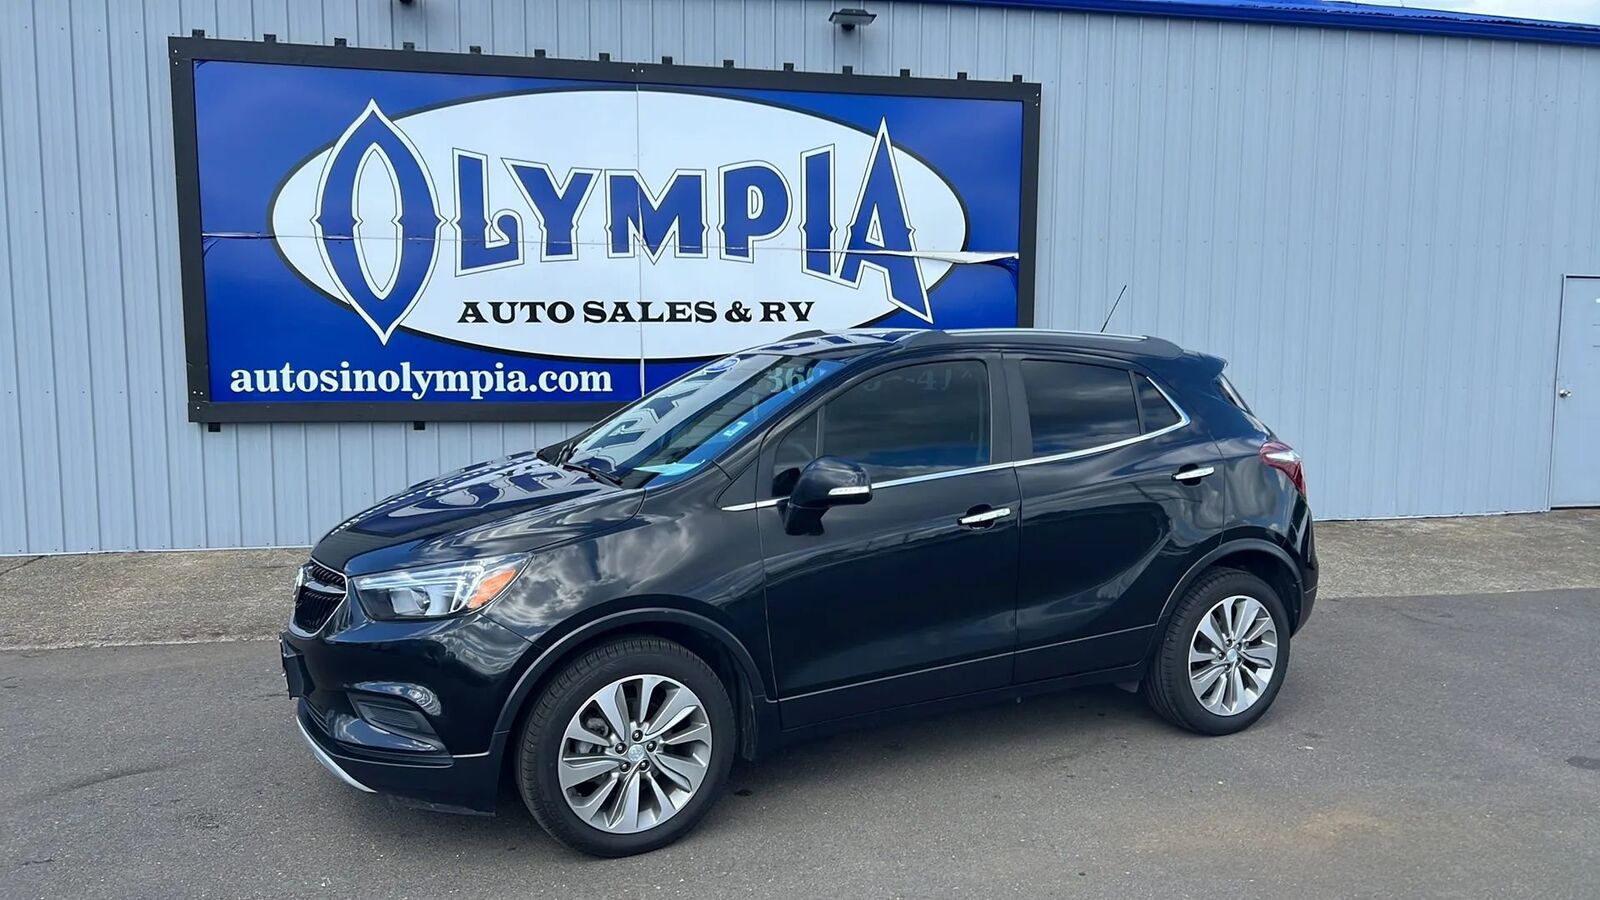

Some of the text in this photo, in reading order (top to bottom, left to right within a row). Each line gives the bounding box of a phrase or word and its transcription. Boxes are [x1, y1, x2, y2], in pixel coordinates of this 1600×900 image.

[310, 98, 934, 344] OLYMPIA
[457, 300, 815, 323] AUTO SALES & RV
[230, 361, 613, 400] autosinolympia.com
